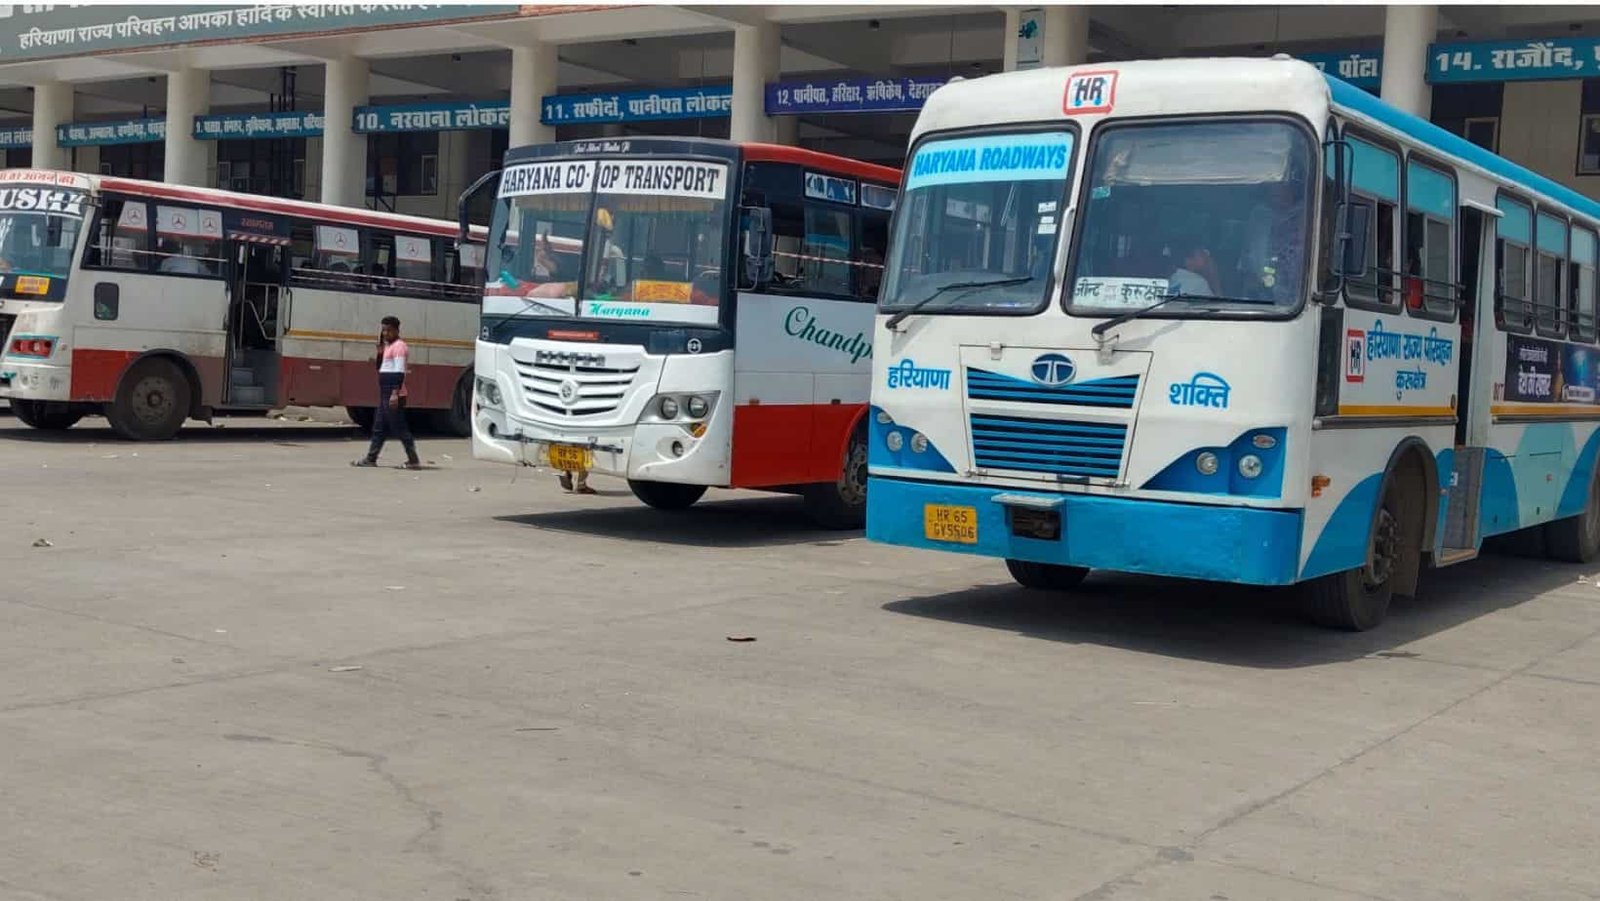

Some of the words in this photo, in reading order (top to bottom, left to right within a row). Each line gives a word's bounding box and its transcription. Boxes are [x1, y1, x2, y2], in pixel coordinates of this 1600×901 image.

[18, 27, 75, 50] हरियाणा
[78, 25, 113, 43] राज्य
[114, 15, 175, 38] परिवहन
[178, 9, 233, 31] आपका
[1435, 52, 1482, 72] 14.
[793, 83, 830, 106] पानीपत,
[1075, 76, 1105, 102] HR
[356, 112, 385, 131] 10.
[390, 110, 451, 130] नरवाना
[545, 103, 569, 120] 11.
[629, 94, 682, 116] पानीपत
[914, 148, 976, 178] HARYANA
[980, 144, 1067, 171] ROADWAYS
[502, 165, 561, 193] HARYANA
[600, 164, 620, 188] OP
[624, 164, 719, 193] TRANSPORT
[784, 305, 873, 364] Chandp
[1367, 319, 1402, 361] हरियाणा
[1403, 333, 1423, 360] राज्य
[1424, 326, 1453, 366] परिवहन
[888, 358, 952, 391] हरियाणा
[1169, 371, 1231, 409] शक्ति
[936, 508, 950, 522] HR
[954, 510, 968, 523] 65
